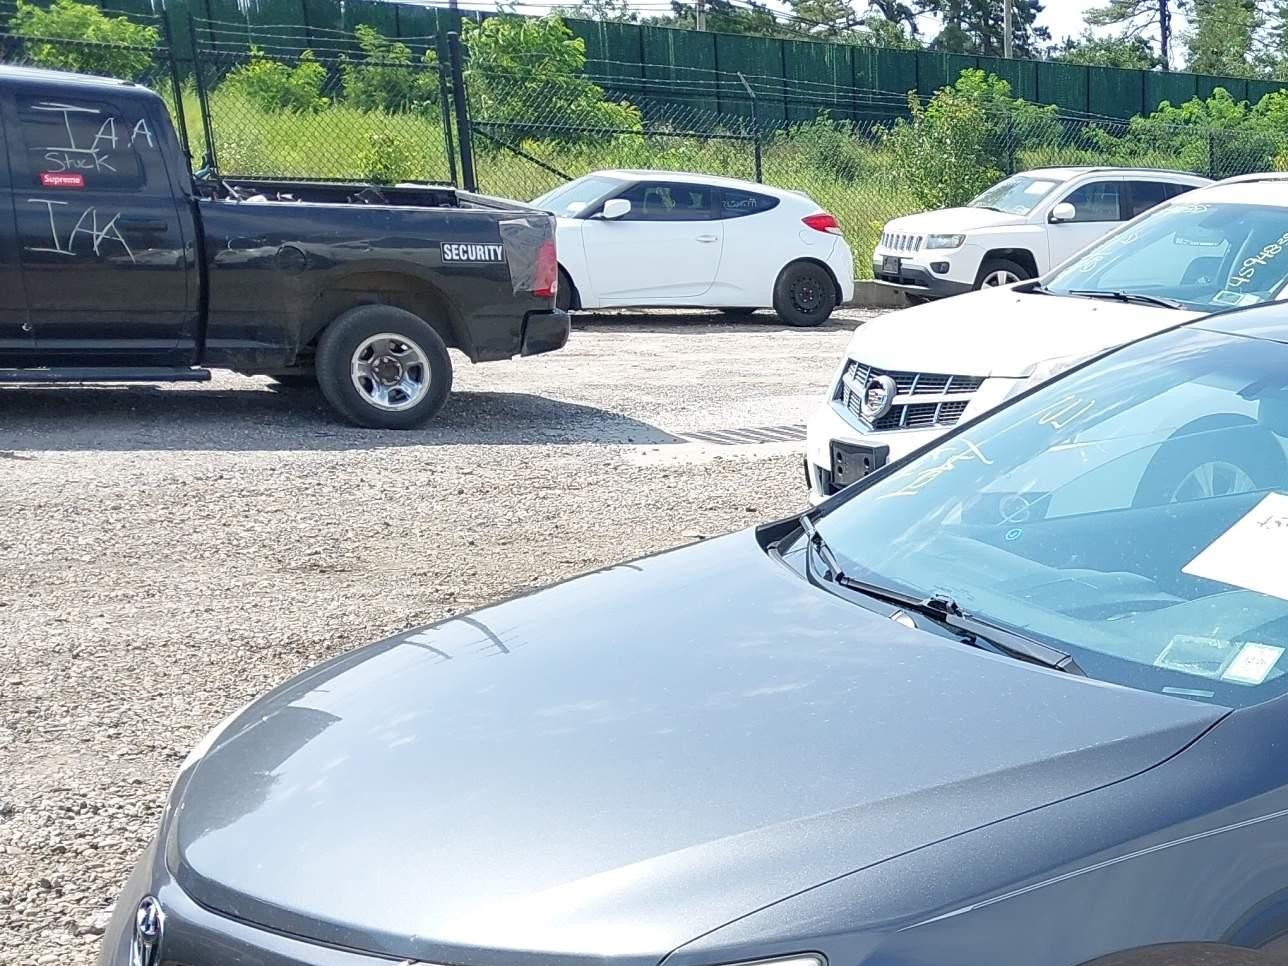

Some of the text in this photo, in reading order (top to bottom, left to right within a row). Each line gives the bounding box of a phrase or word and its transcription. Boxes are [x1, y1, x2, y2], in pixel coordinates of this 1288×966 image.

[43, 174, 81, 185] Supreme
[24, 199, 136, 264] IAA
[443, 244, 503, 261] SECURITY
